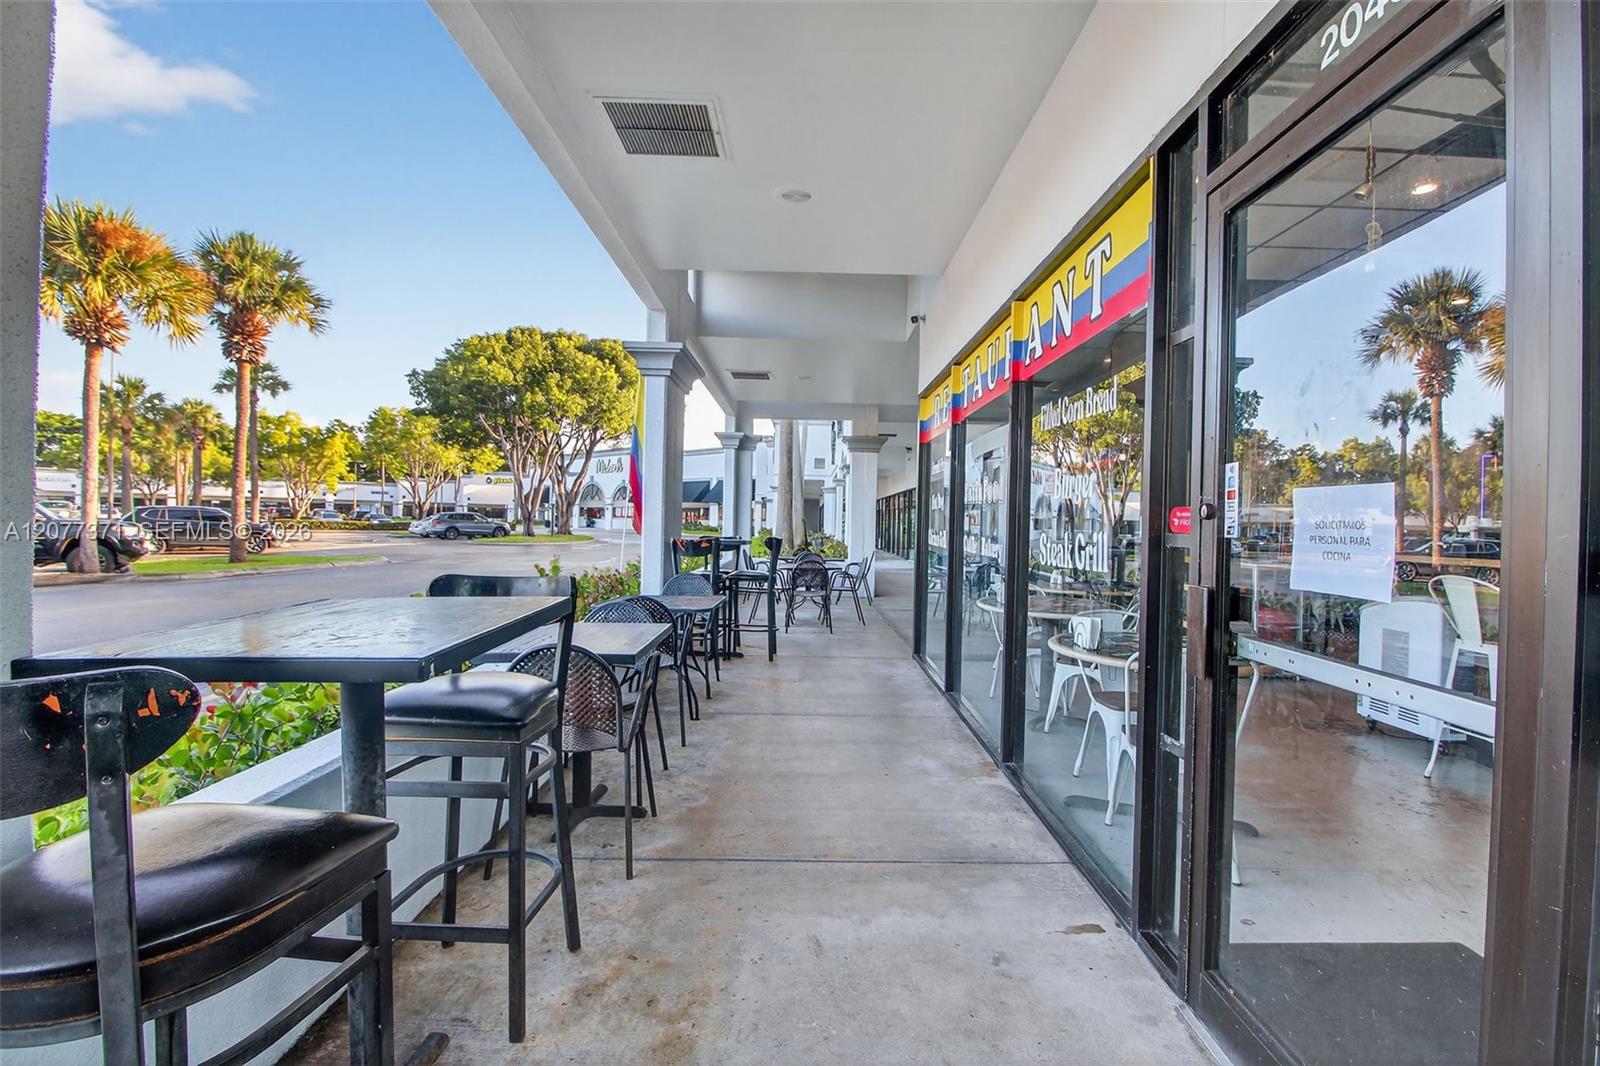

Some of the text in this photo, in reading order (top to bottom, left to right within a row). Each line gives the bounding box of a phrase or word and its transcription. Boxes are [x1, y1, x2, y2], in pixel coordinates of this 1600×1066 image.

[1320, 0, 1401, 71] 204
[1062, 396, 1084, 425] Corn
[1086, 375, 1118, 418] Bread
[1054, 468, 1098, 504] Burger
[1309, 535, 1371, 546] PERSONAL PARA
[1314, 520, 1366, 530] SOLICITAMOS
[1039, 530, 1073, 568] Steak
[1075, 531, 1108, 573] Grill
[1322, 551, 1351, 561] COCINA
